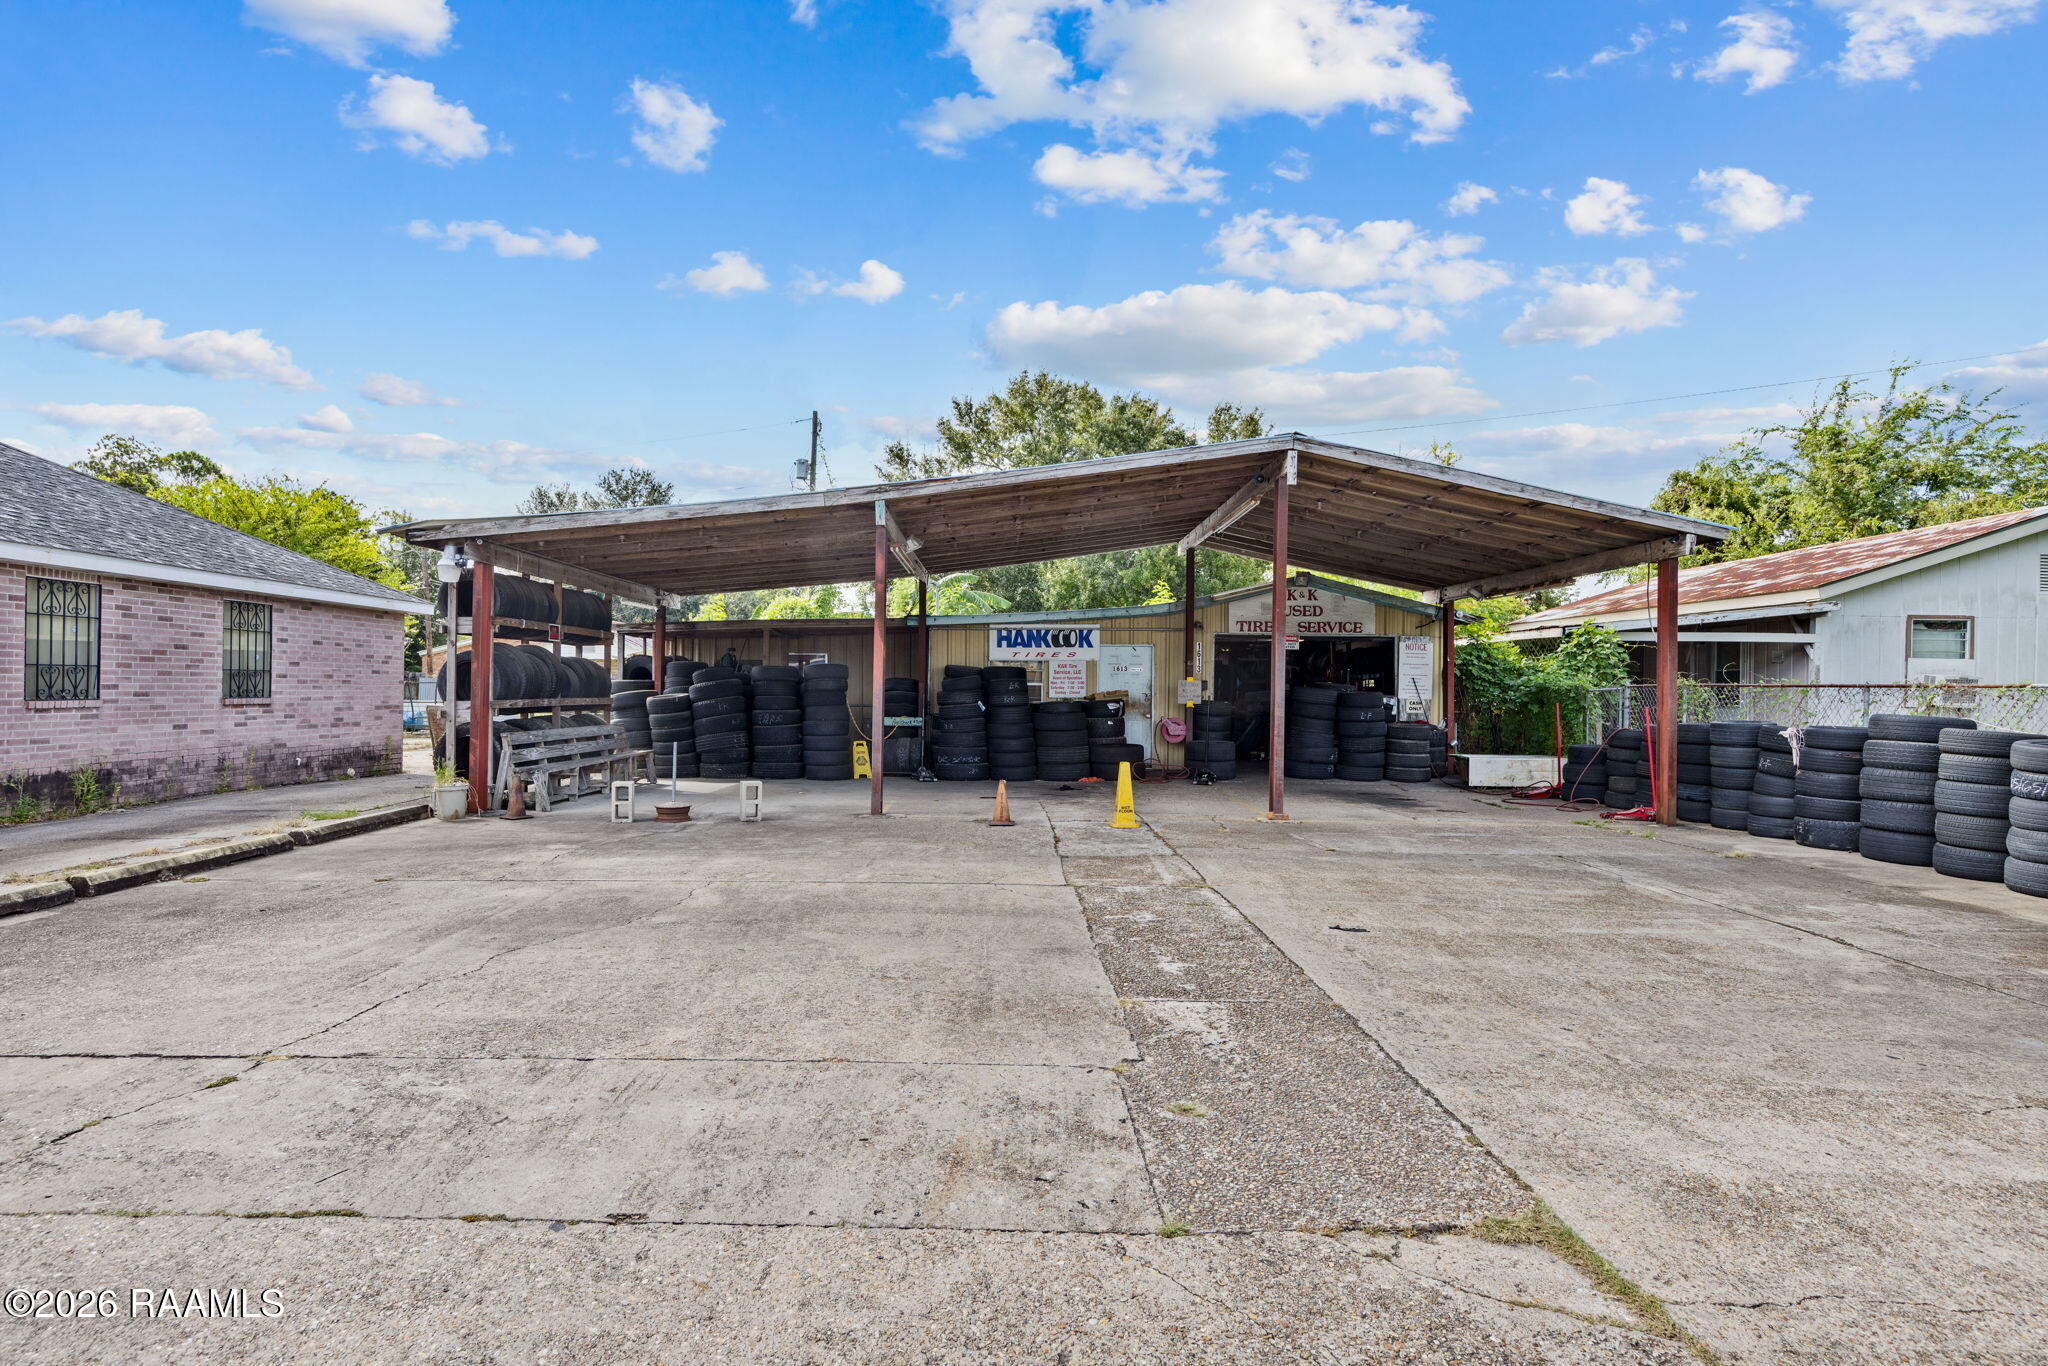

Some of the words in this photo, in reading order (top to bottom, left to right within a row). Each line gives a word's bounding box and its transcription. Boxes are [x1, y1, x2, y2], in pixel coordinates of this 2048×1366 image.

[1287, 589, 1298, 601] K
[1308, 589, 1318, 601] K
[1297, 621, 1363, 633] SERVICE
[996, 628, 1094, 648] HANKOOK
[1405, 643, 1428, 652] NOTICE
